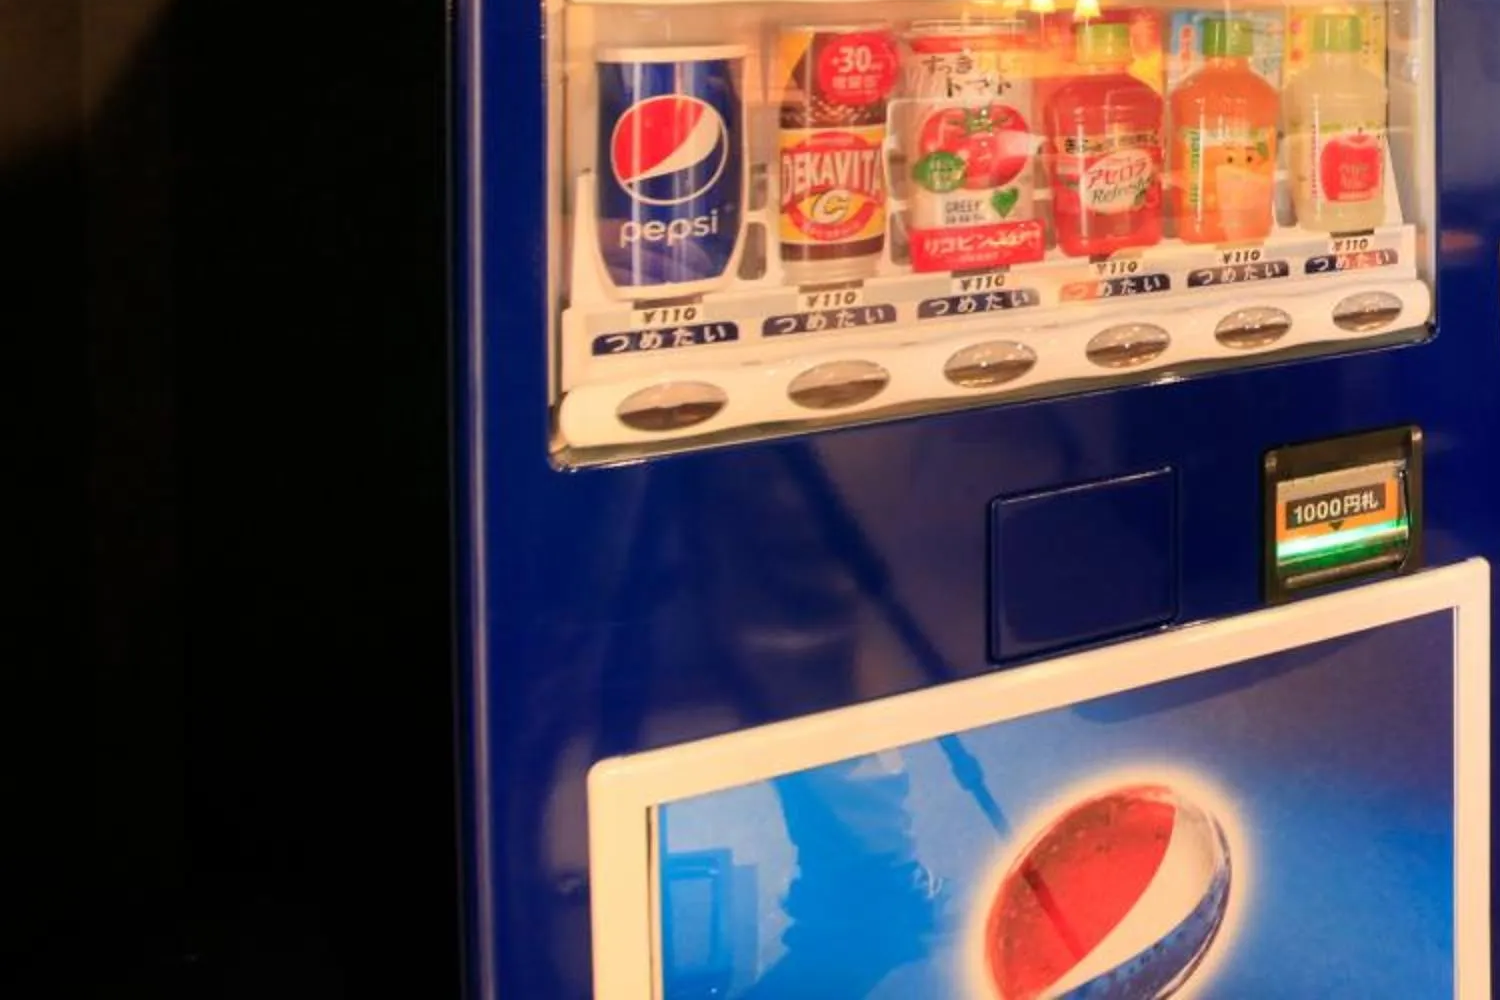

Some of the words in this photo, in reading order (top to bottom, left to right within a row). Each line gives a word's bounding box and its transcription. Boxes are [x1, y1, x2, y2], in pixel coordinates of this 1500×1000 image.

[620, 211, 718, 248] pepsi
[1199, 264, 1281, 287] つめたい
[642, 308, 697, 324] ¥110
[929, 292, 1029, 315] つめたい
[776, 308, 886, 334] つめたい
[605, 325, 727, 352] つめたい
[1293, 491, 1379, 524] 1000円札
